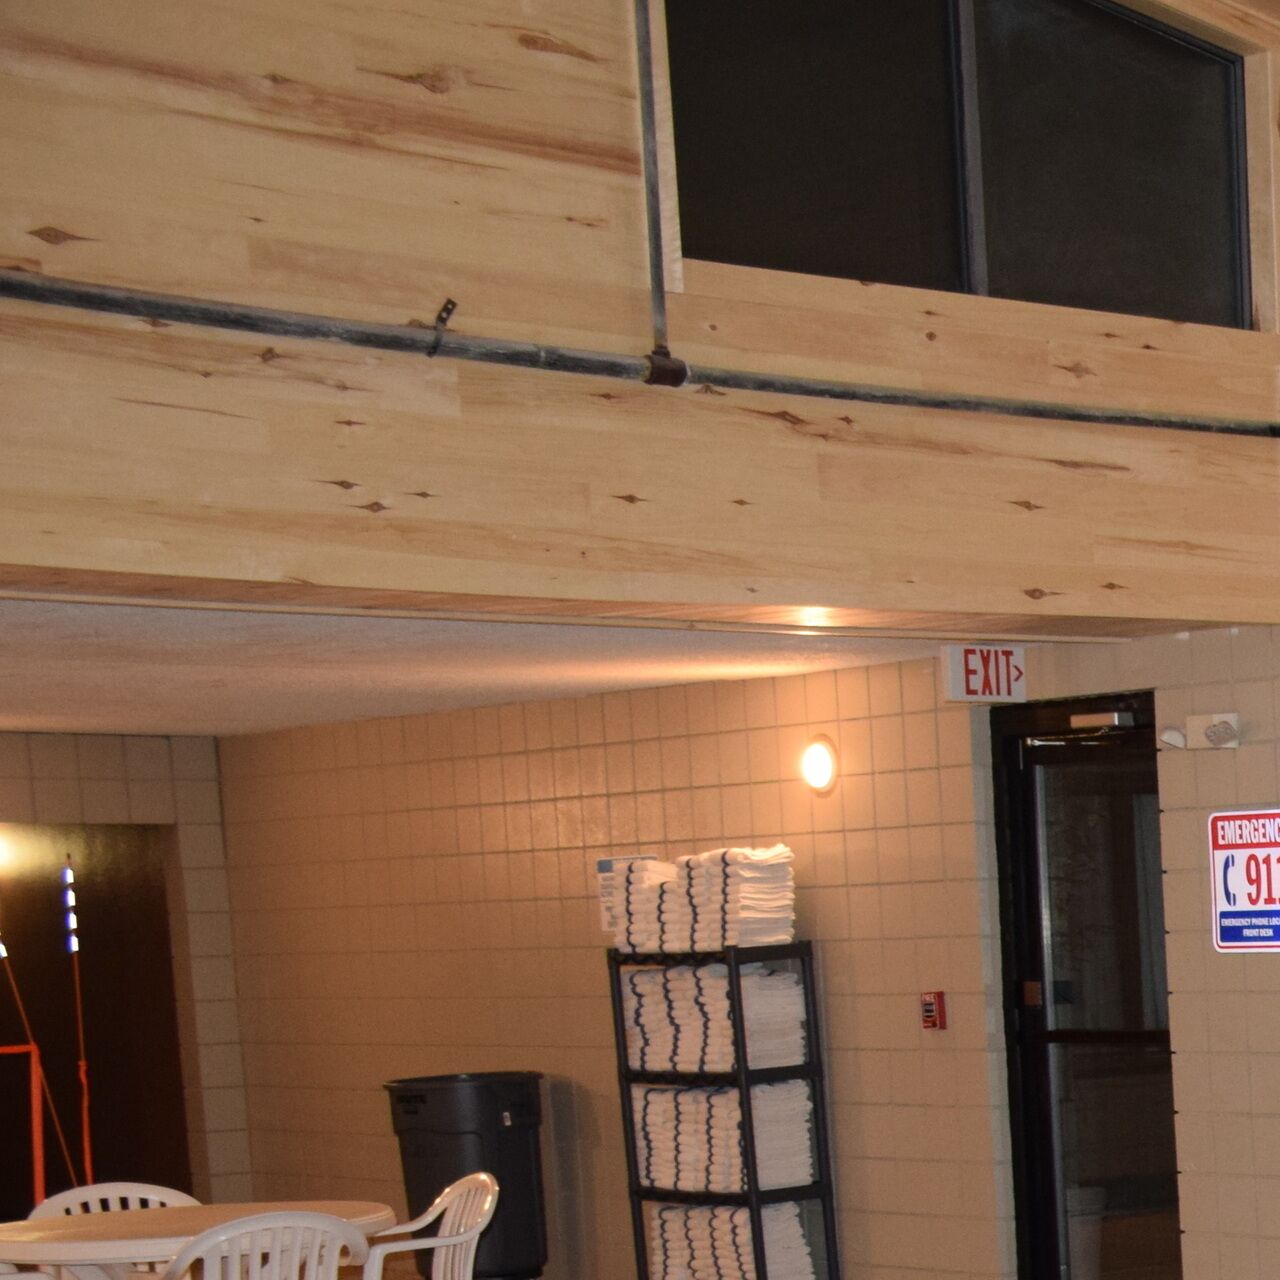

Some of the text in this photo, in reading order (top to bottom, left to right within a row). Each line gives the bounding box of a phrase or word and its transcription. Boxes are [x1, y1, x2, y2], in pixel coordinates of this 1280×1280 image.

[963, 648, 1013, 696] EXIT
[1221, 918, 1251, 927] EMERGENCY
[1251, 917, 1269, 926] PHONE
[1243, 929, 1259, 937] FRONT
